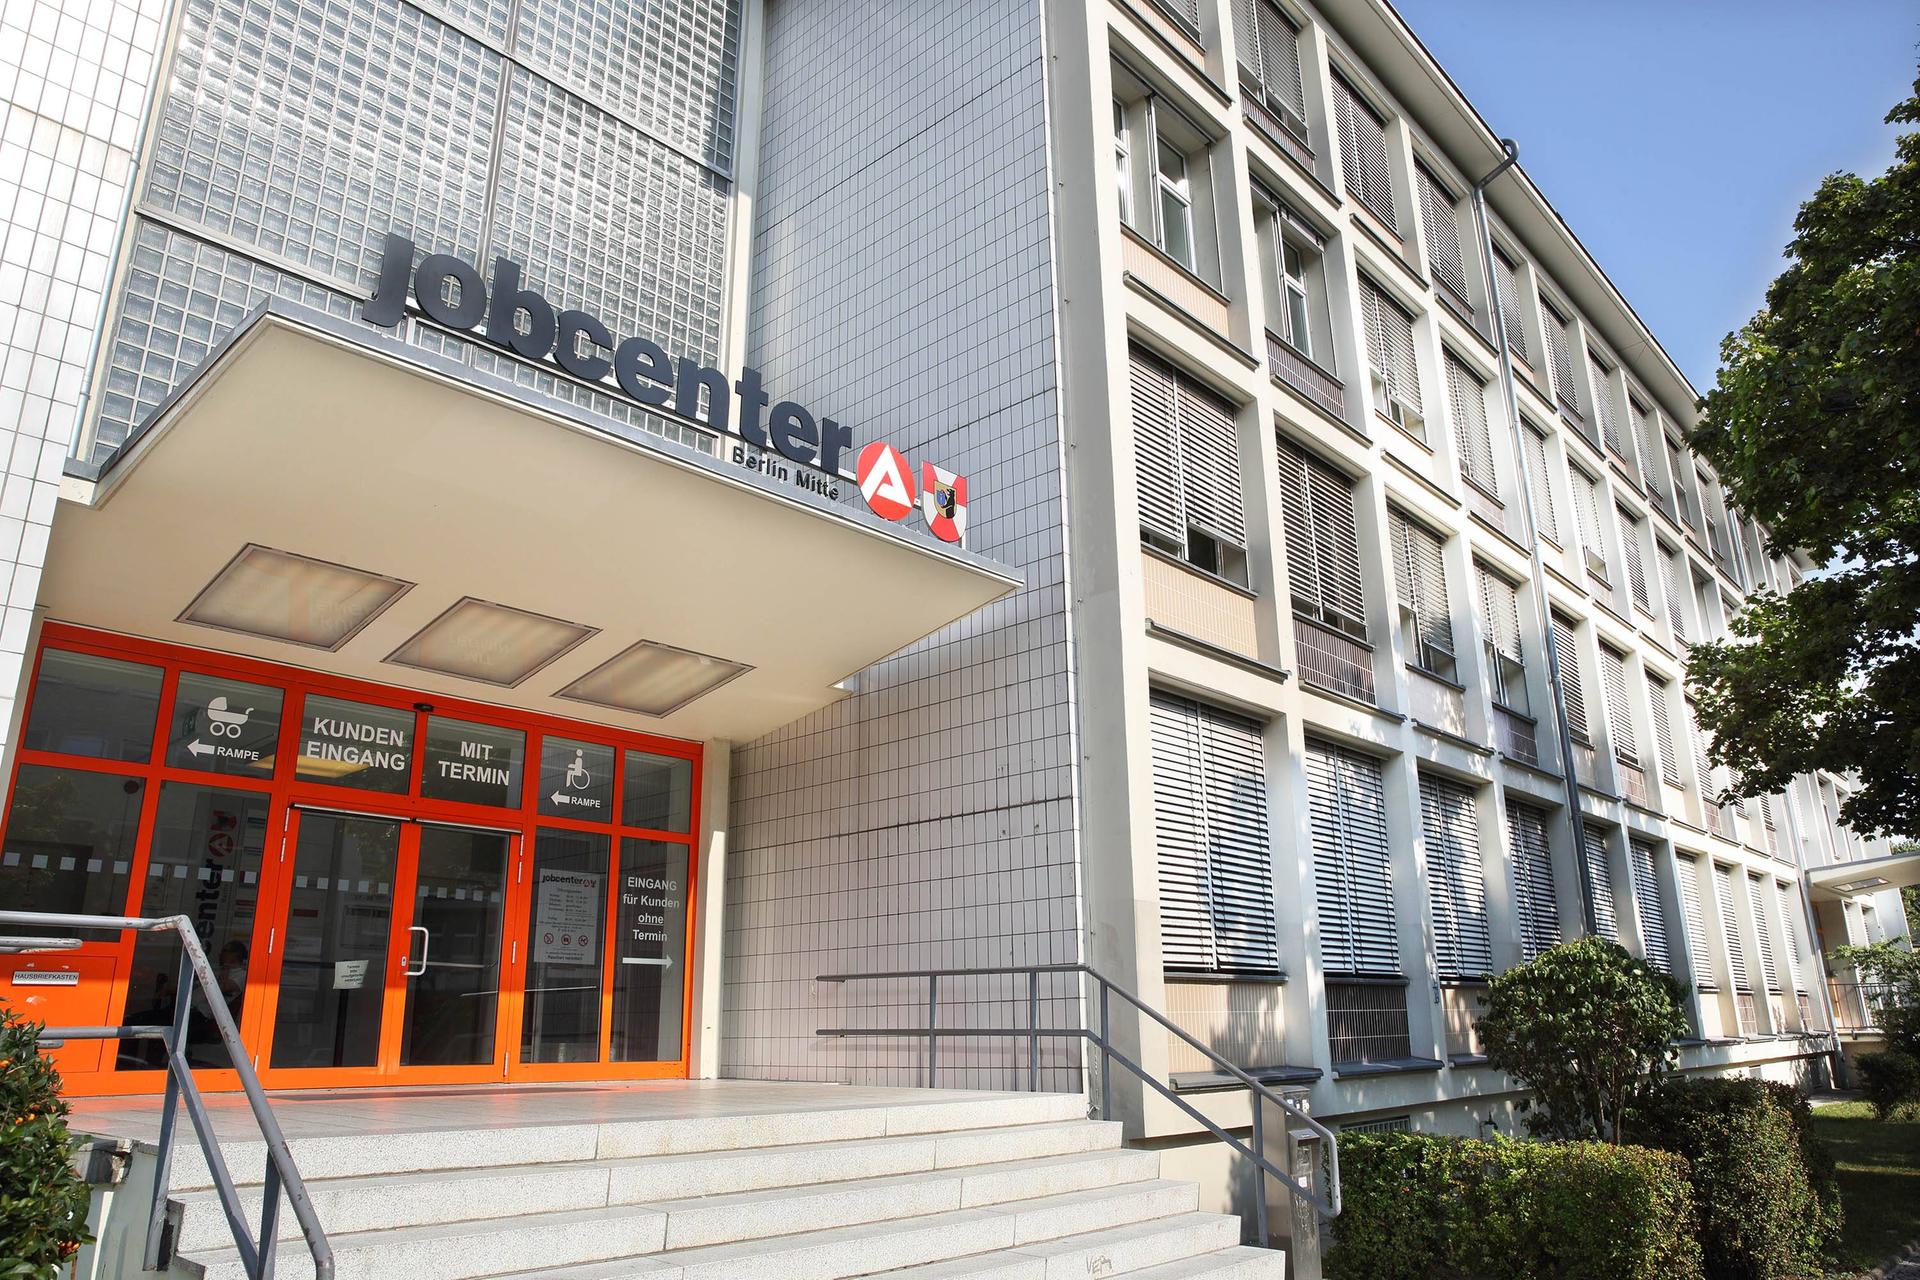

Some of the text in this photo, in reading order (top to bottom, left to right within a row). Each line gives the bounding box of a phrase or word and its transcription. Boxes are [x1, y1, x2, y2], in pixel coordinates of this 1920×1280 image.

[732, 446, 839, 501] Berlin Mitte
[313, 717, 404, 747] KUNDEN
[217, 746, 259, 761] RAMPE
[306, 741, 405, 770] EINGANG
[460, 741, 493, 761] MIT
[438, 760, 510, 786] TERMIN
[571, 796, 601, 808] RAMPE
[628, 877, 677, 890] EINGANG
[623, 893, 680, 908] für Kunden
[638, 913, 664, 925] ohne
[633, 929, 667, 941] Termin
